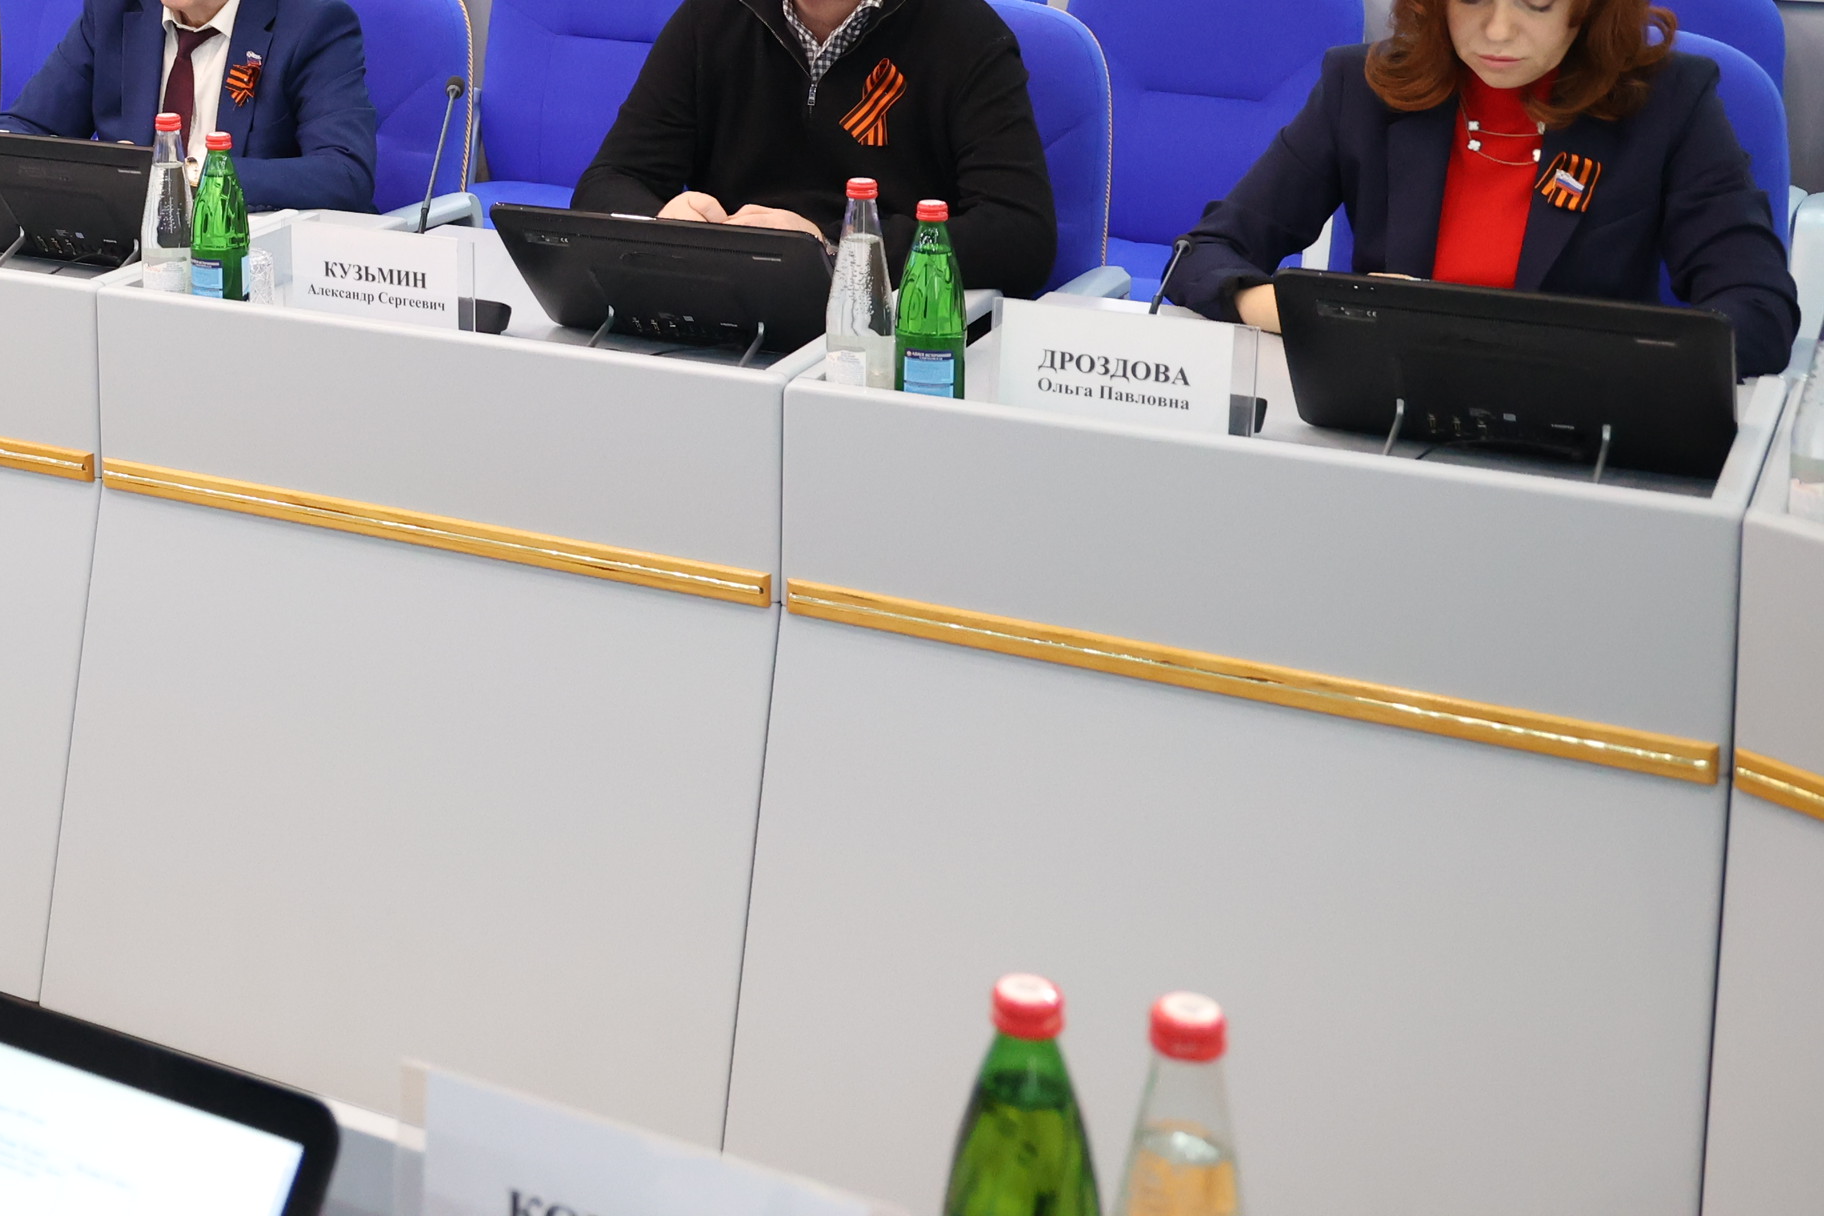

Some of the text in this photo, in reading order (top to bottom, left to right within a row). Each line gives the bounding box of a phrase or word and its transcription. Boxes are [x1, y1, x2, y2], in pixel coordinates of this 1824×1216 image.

[324, 260, 427, 289] КУЗЬМИН
[307, 284, 445, 312] Александр Сергеевич
[1038, 348, 1191, 387] ДРОЗДОВА
[1038, 377, 1190, 411] Ольга Павловна
